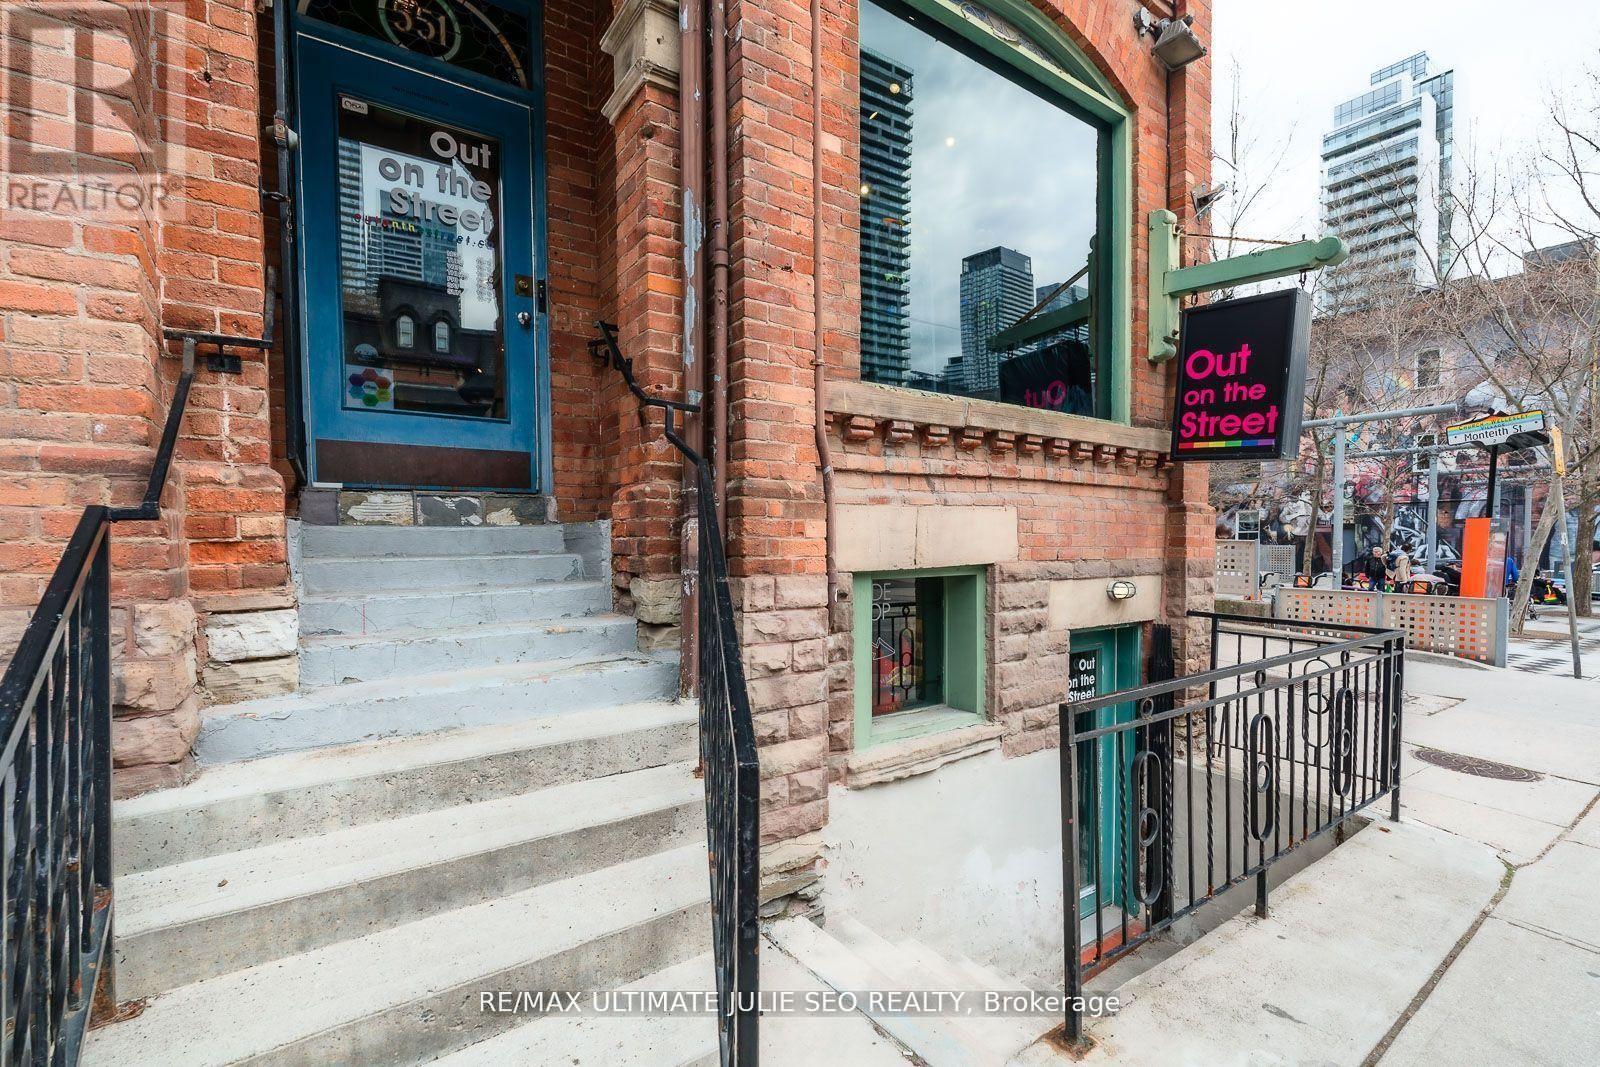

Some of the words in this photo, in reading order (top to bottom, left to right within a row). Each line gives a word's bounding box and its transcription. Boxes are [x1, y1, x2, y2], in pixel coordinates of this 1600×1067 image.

[430, 131, 491, 168] Out
[379, 157, 425, 188] on
[436, 166, 492, 203] the
[390, 187, 494, 235] Street
[1186, 343, 1252, 380] Out
[1184, 388, 1216, 406] on
[1224, 381, 1267, 403] the
[1180, 405, 1279, 438] Street
[1464, 428, 1509, 441] Monteith
[1512, 424, 1526, 434] St.
[1078, 657, 1096, 671] Out
[1068, 687, 1096, 703] Street
[1080, 674, 1096, 687] the
